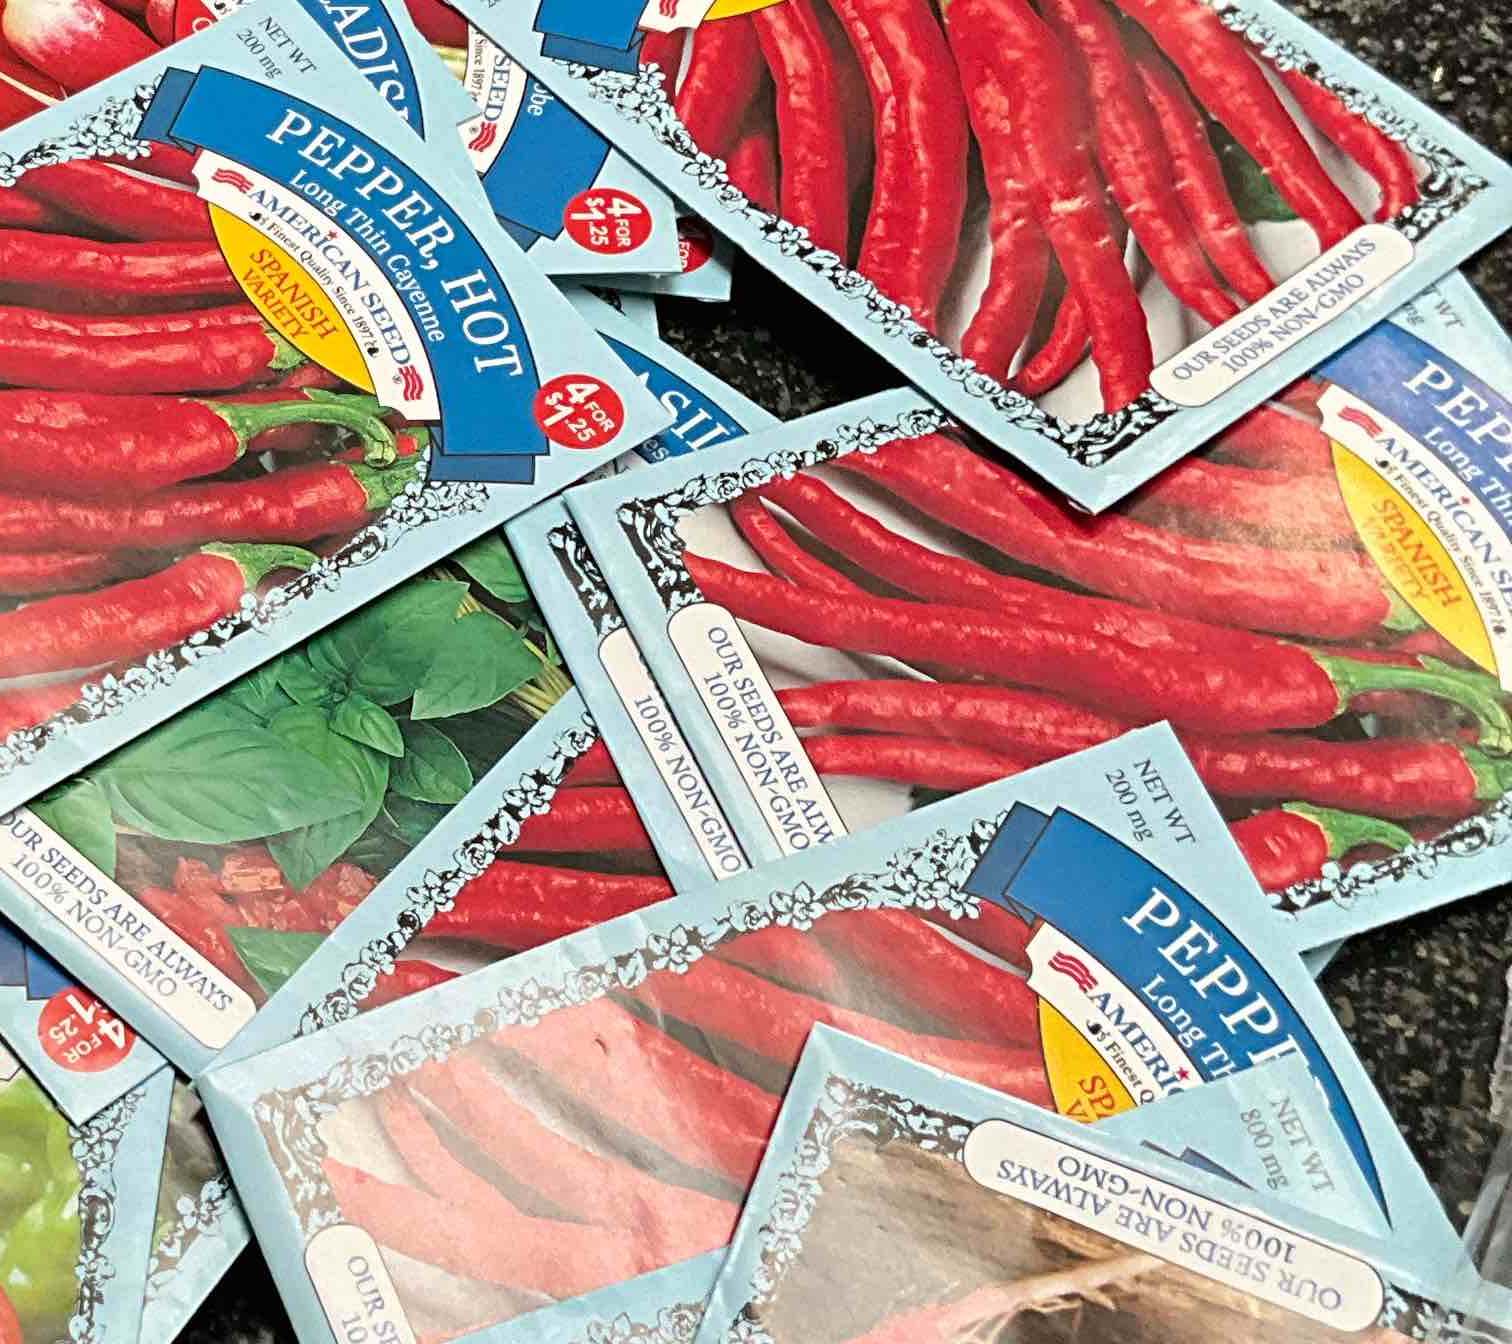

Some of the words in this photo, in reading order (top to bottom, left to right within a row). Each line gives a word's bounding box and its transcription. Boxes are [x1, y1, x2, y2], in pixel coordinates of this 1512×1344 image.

[236, 28, 263, 54] 200
[260, 55, 283, 79] mg
[258, 16, 291, 49] NET
[288, 47, 316, 73] WT
[265, 109, 455, 272] PEPPER,
[441, 269, 525, 377] HOT
[606, 198, 643, 217] 4
[615, 219, 632, 247] FOR
[248, 186, 370, 291] AMERICAN
[361, 291, 412, 366] SEED
[267, 221, 301, 252] Finest
[299, 249, 334, 288] Quality
[332, 286, 356, 316] Since
[351, 314, 372, 343] 1897
[290, 170, 339, 217] Long
[346, 207, 388, 256] Thin
[387, 252, 445, 341] Cayenne
[242, 268, 311, 341] VARIETY
[249, 248, 339, 340] SPANISH
[1172, 350, 1216, 381] OUR
[1212, 315, 1271, 354] SEEDS
[1268, 287, 1308, 321] ARE
[1305, 237, 1376, 293] ALWAYS
[1221, 337, 1274, 375] 100%
[1269, 273, 1365, 343] NON-GMO
[543, 391, 597, 442] $1.25
[565, 383, 600, 405] 4
[583, 402, 615, 432] FOR
[1106, 768, 1136, 807] 200
[1126, 807, 1154, 841] mg
[1133, 758, 1170, 806] NET
[1163, 808, 1196, 847] WT
[12, 854, 72, 905] 100%
[66, 902, 178, 997] NON-GMO
[41, 847, 108, 906] SEEDS
[103, 903, 151, 942] ARE
[147, 939, 234, 1012] ALWAYS
[1240, 1108, 1274, 1148] 800
[1262, 1153, 1289, 1190] mg
[1271, 1096, 1312, 1147] NET
[1302, 1151, 1335, 1191] WT
[996, 1158, 1112, 1217] ALWAYS
[1056, 1154, 1214, 1232] NON-GMO
[1114, 1204, 1178, 1244] ARE
[1178, 1237, 1273, 1285] SEEDS
[1220, 1218, 1297, 1264] 100%
[1276, 1273, 1343, 1311] OUR
